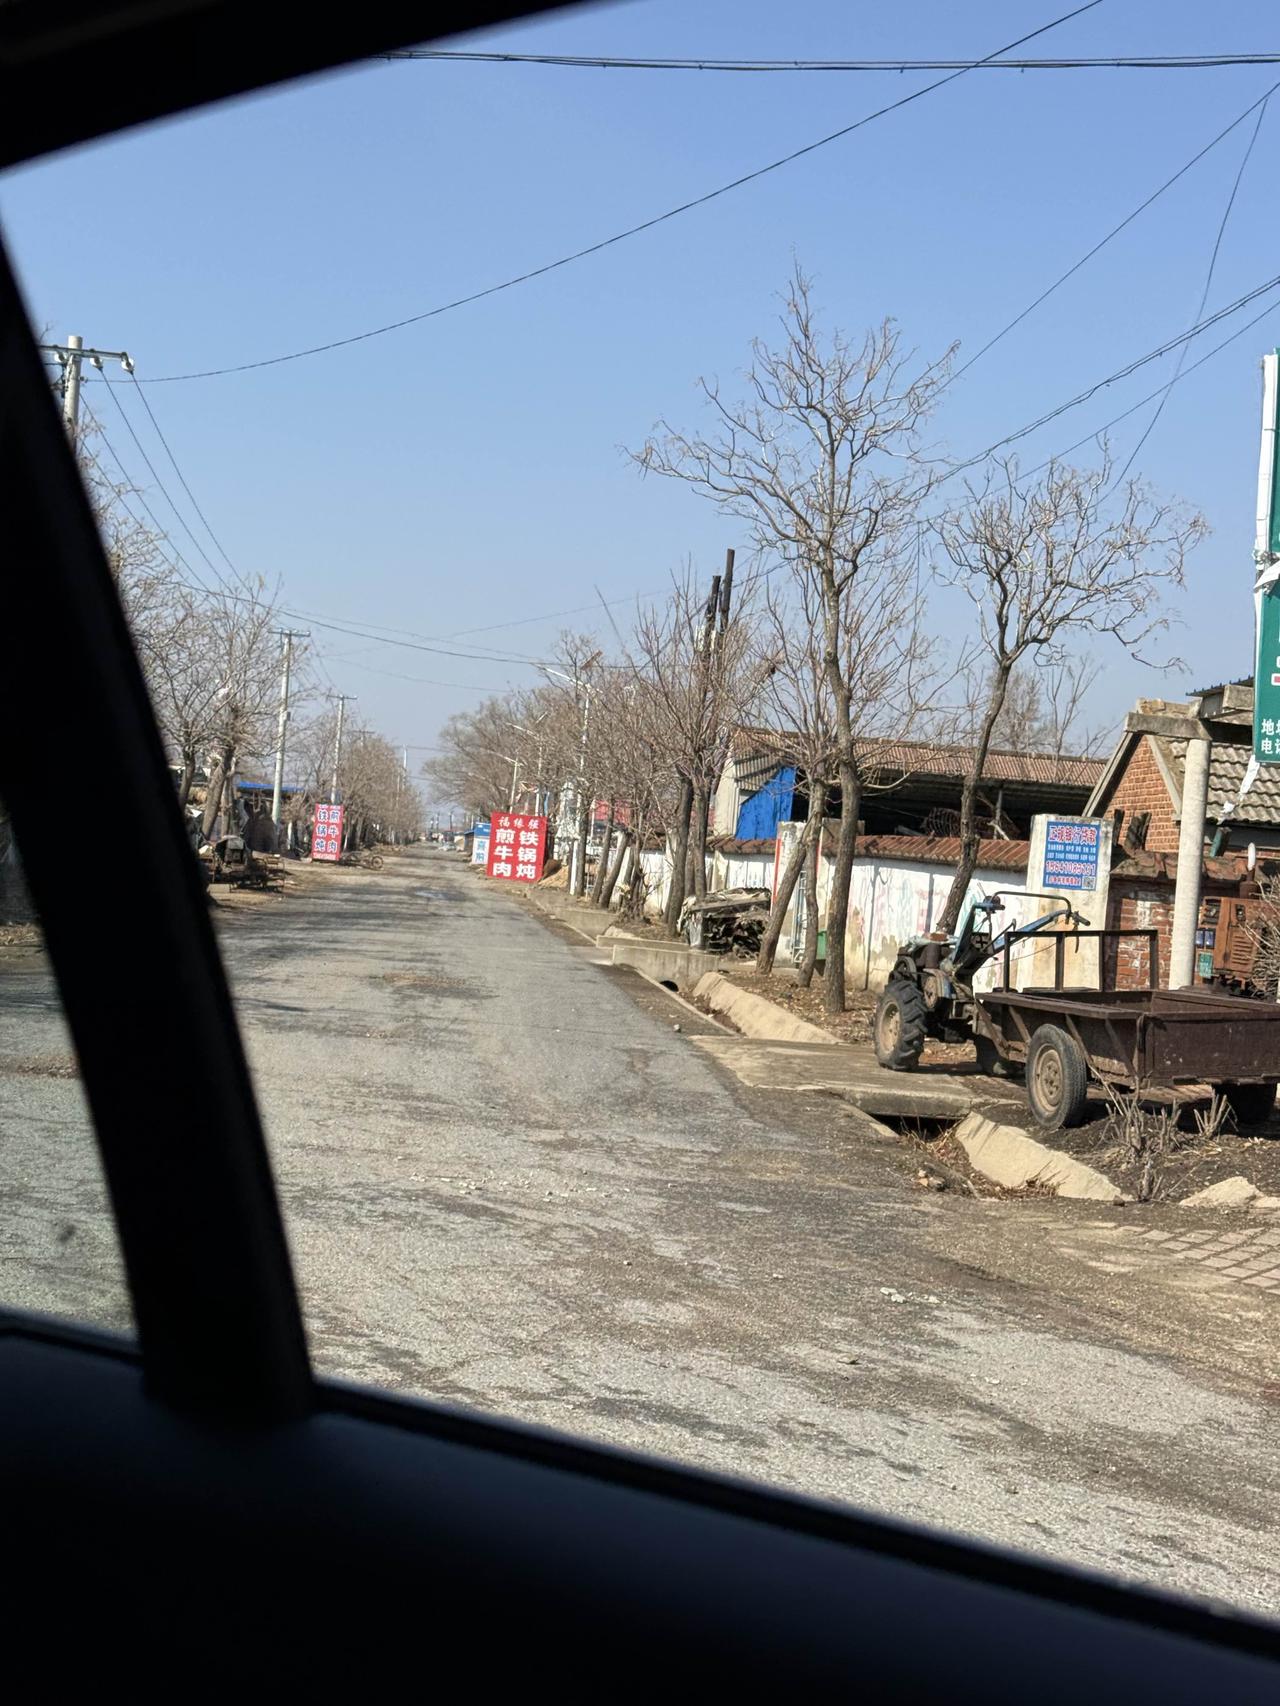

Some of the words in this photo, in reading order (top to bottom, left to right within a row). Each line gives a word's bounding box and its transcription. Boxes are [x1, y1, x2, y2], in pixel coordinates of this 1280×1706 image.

[493, 828, 516, 877] 煎牛肉
[516, 831, 539, 879] 铁锅炖
